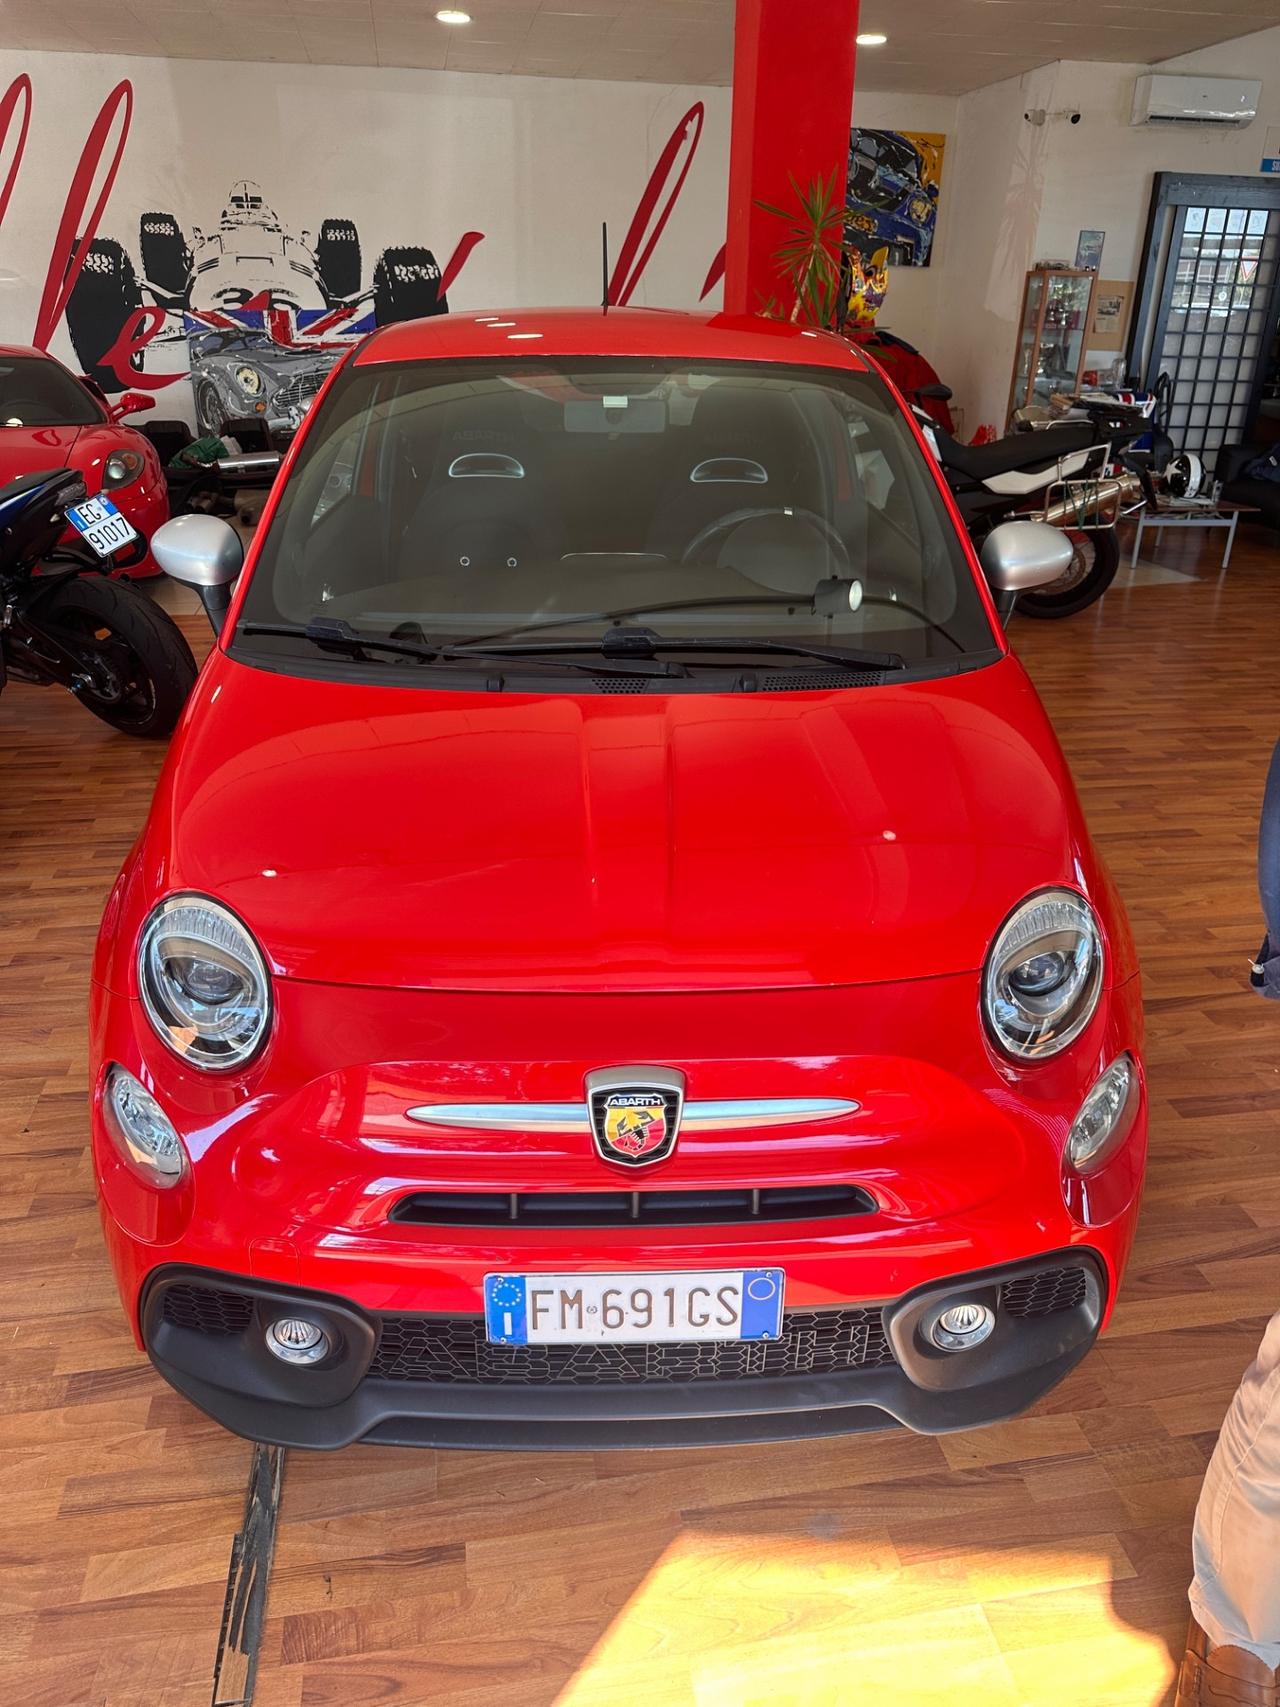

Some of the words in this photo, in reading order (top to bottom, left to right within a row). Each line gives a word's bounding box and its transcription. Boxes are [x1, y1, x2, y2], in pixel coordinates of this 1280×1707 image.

[77, 503, 102, 525] EC
[88, 516, 130, 550] 91017
[609, 1097, 661, 1106] ABARTH
